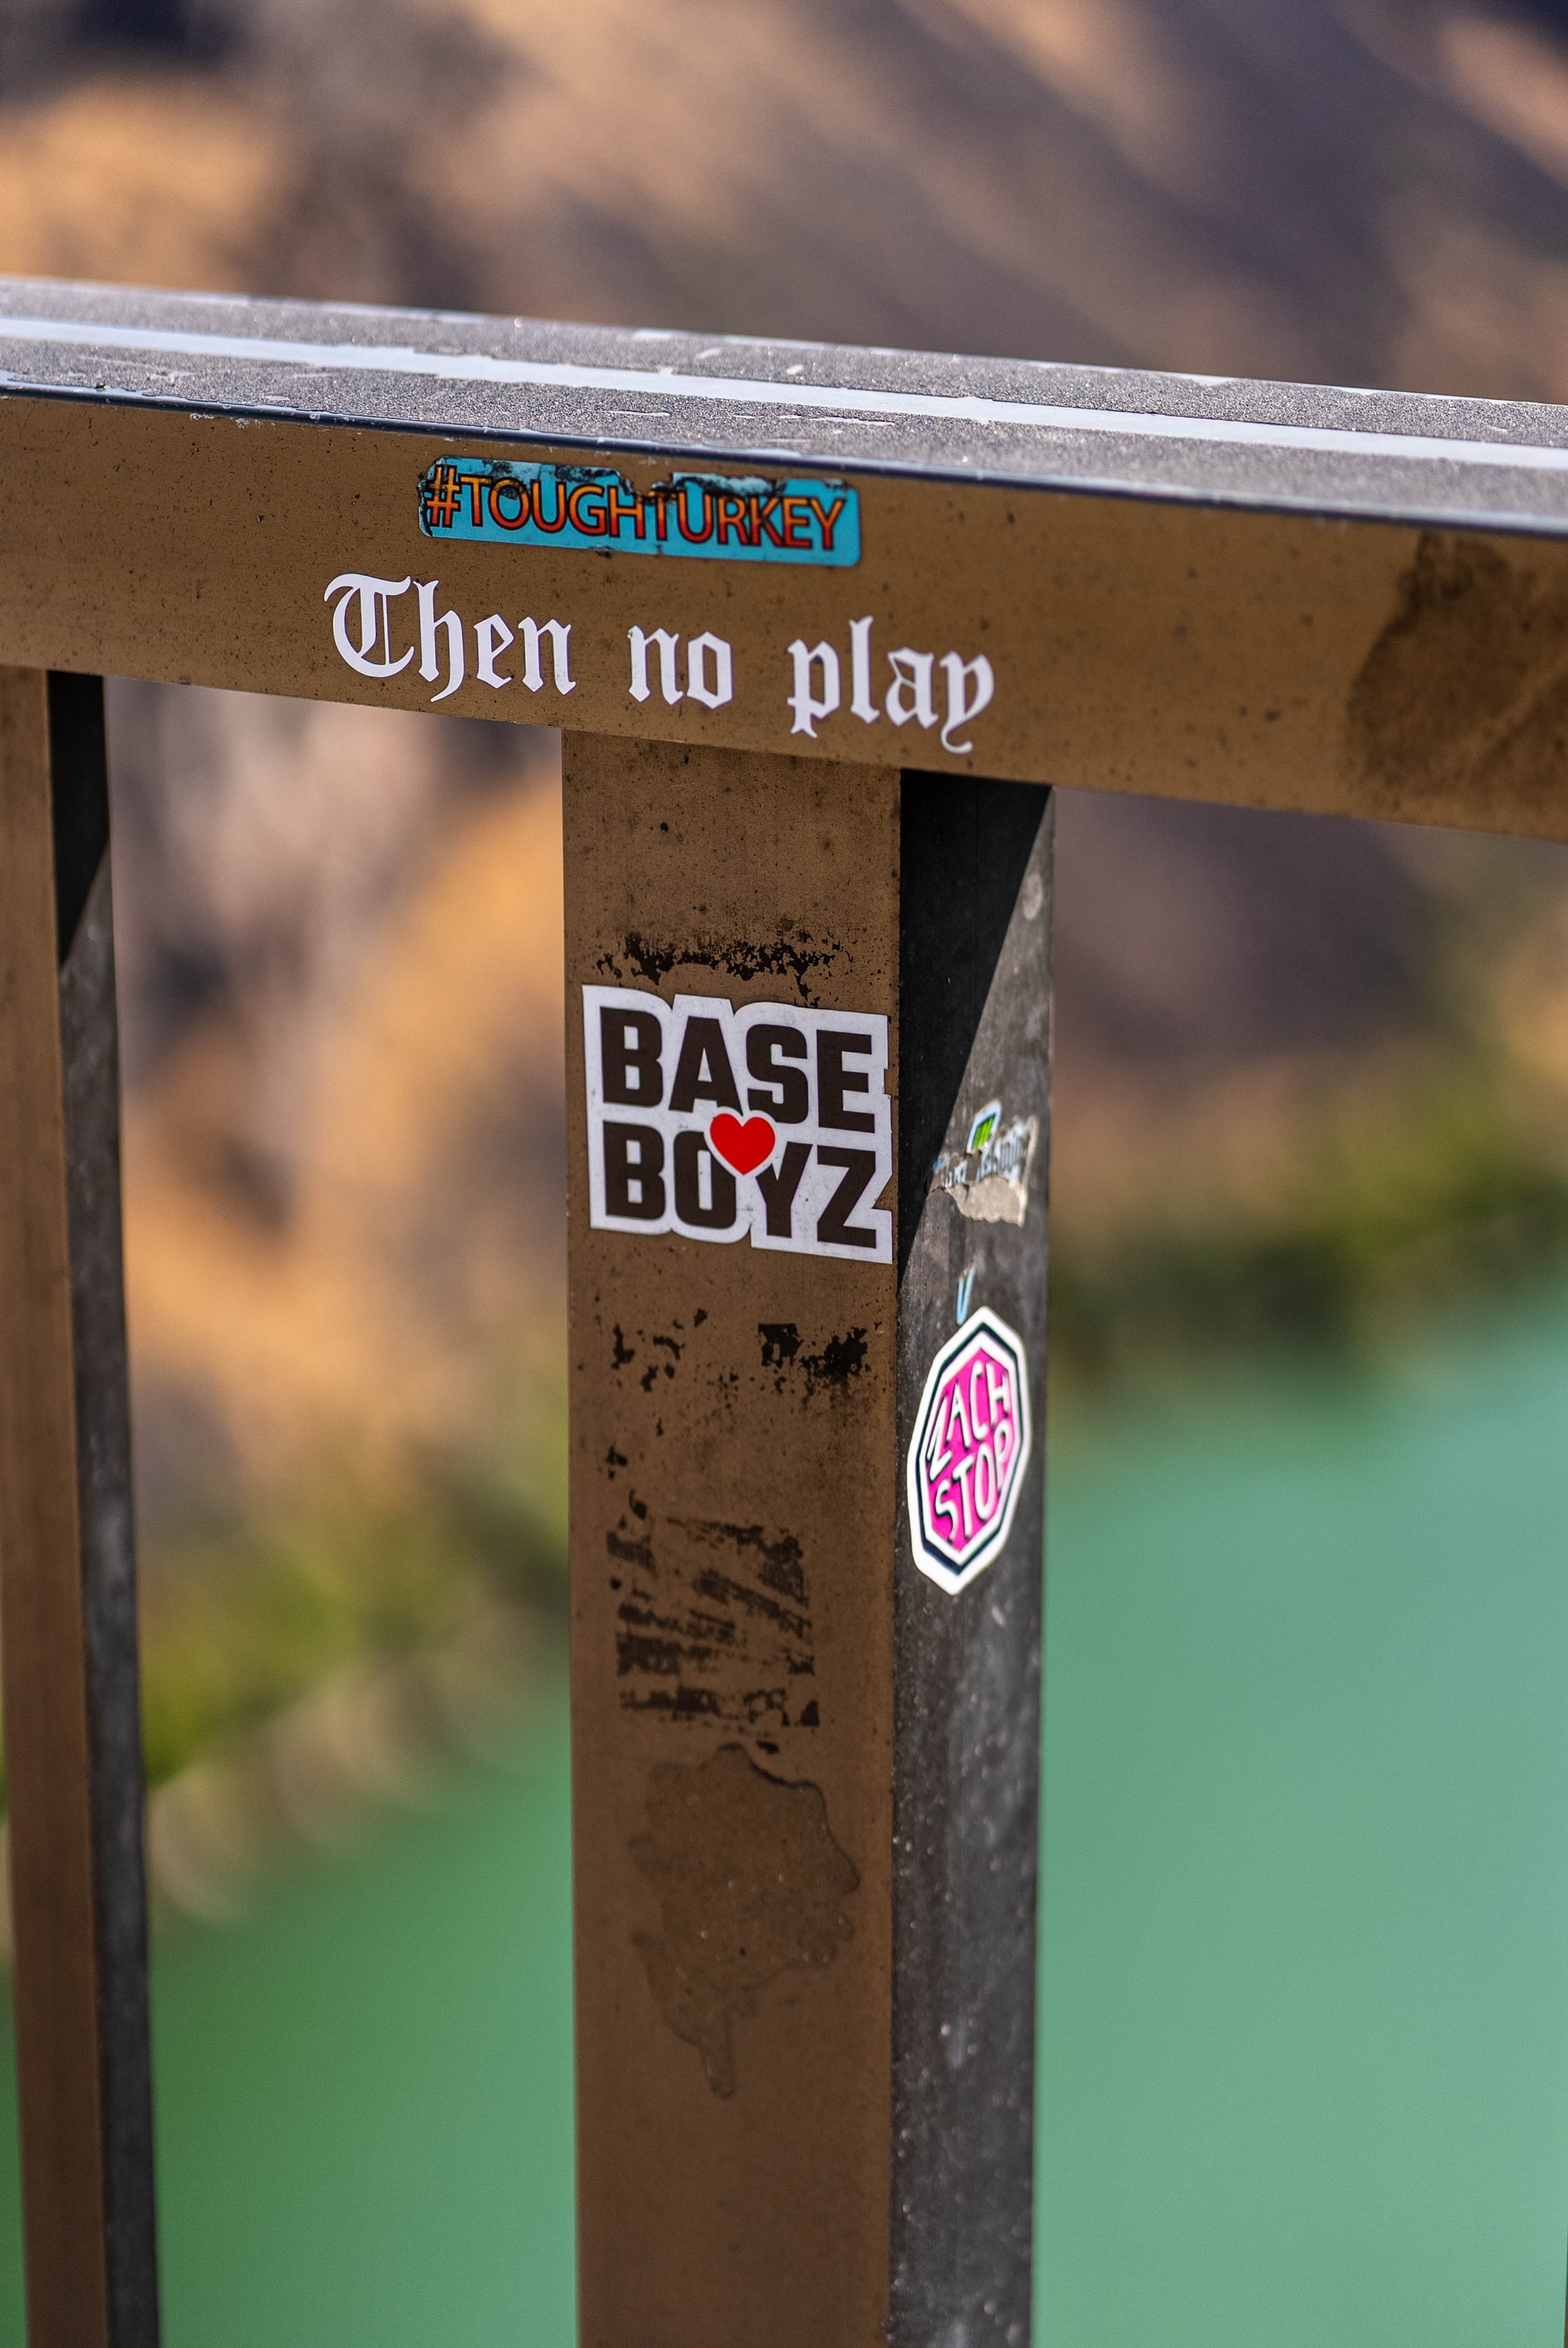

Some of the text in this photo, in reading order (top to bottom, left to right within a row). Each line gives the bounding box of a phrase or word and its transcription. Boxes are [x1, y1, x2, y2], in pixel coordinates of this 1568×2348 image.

[323, 573, 995, 753] Then no play
[600, 1006, 876, 1134] BASE
[603, 1120, 877, 1249] BOYZ
[926, 1359, 1010, 1483] ZACH
[935, 1418, 1012, 1543] STOP
